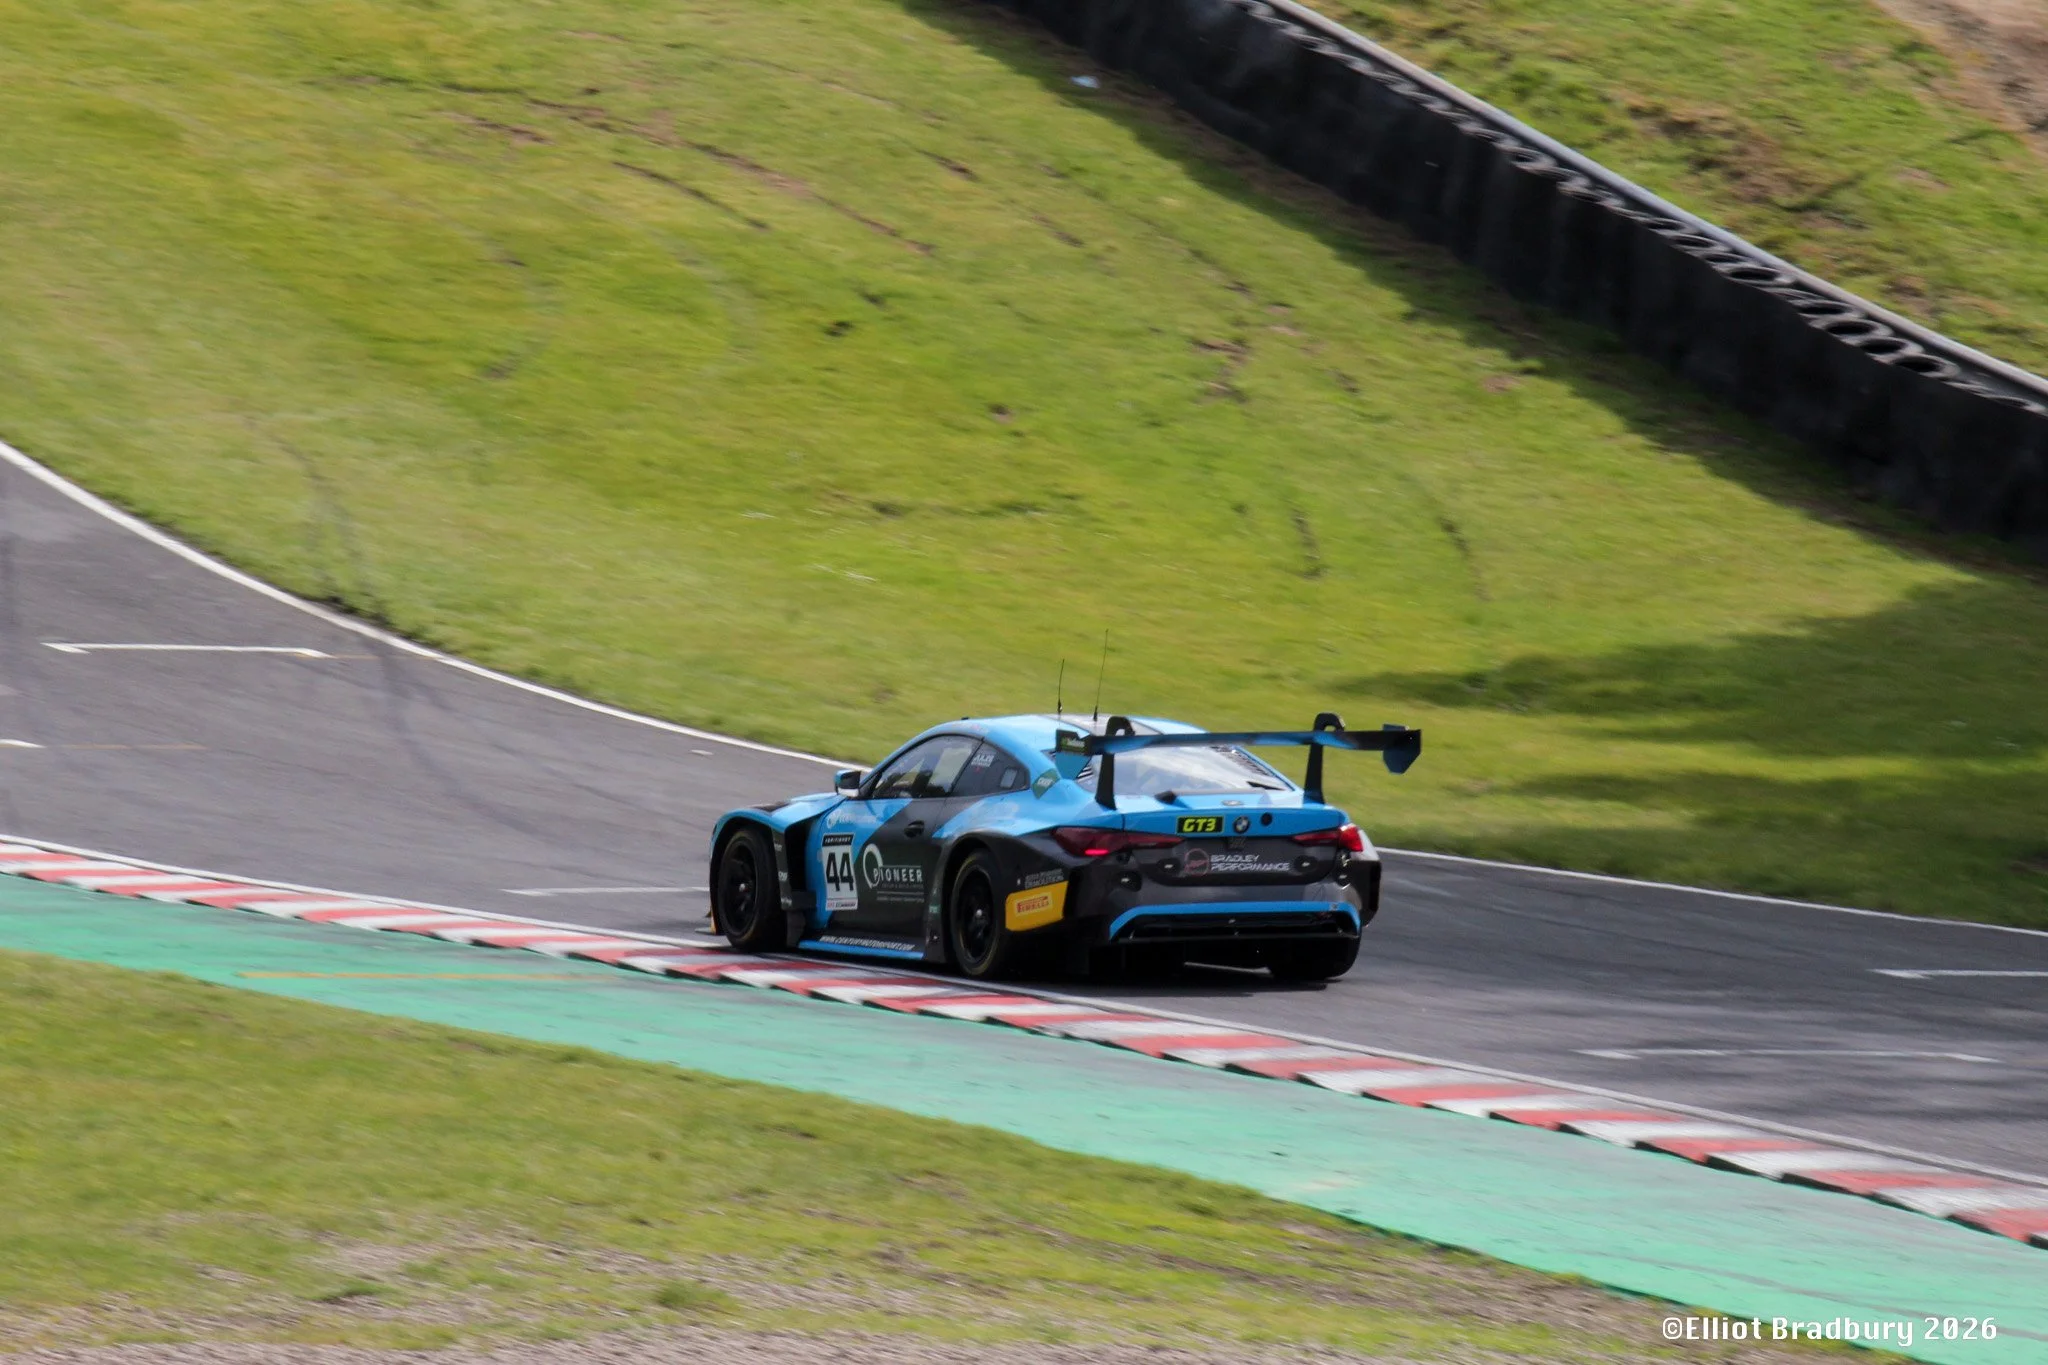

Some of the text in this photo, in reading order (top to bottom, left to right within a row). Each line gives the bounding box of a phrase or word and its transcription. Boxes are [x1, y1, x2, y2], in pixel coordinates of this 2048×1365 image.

[1182, 818, 1217, 832] GT3
[1210, 854, 1260, 863] BRADLEY
[826, 852, 854, 892] 44
[1210, 862, 1291, 872] PERFORMANCE
[873, 868, 923, 883] PIONEER
